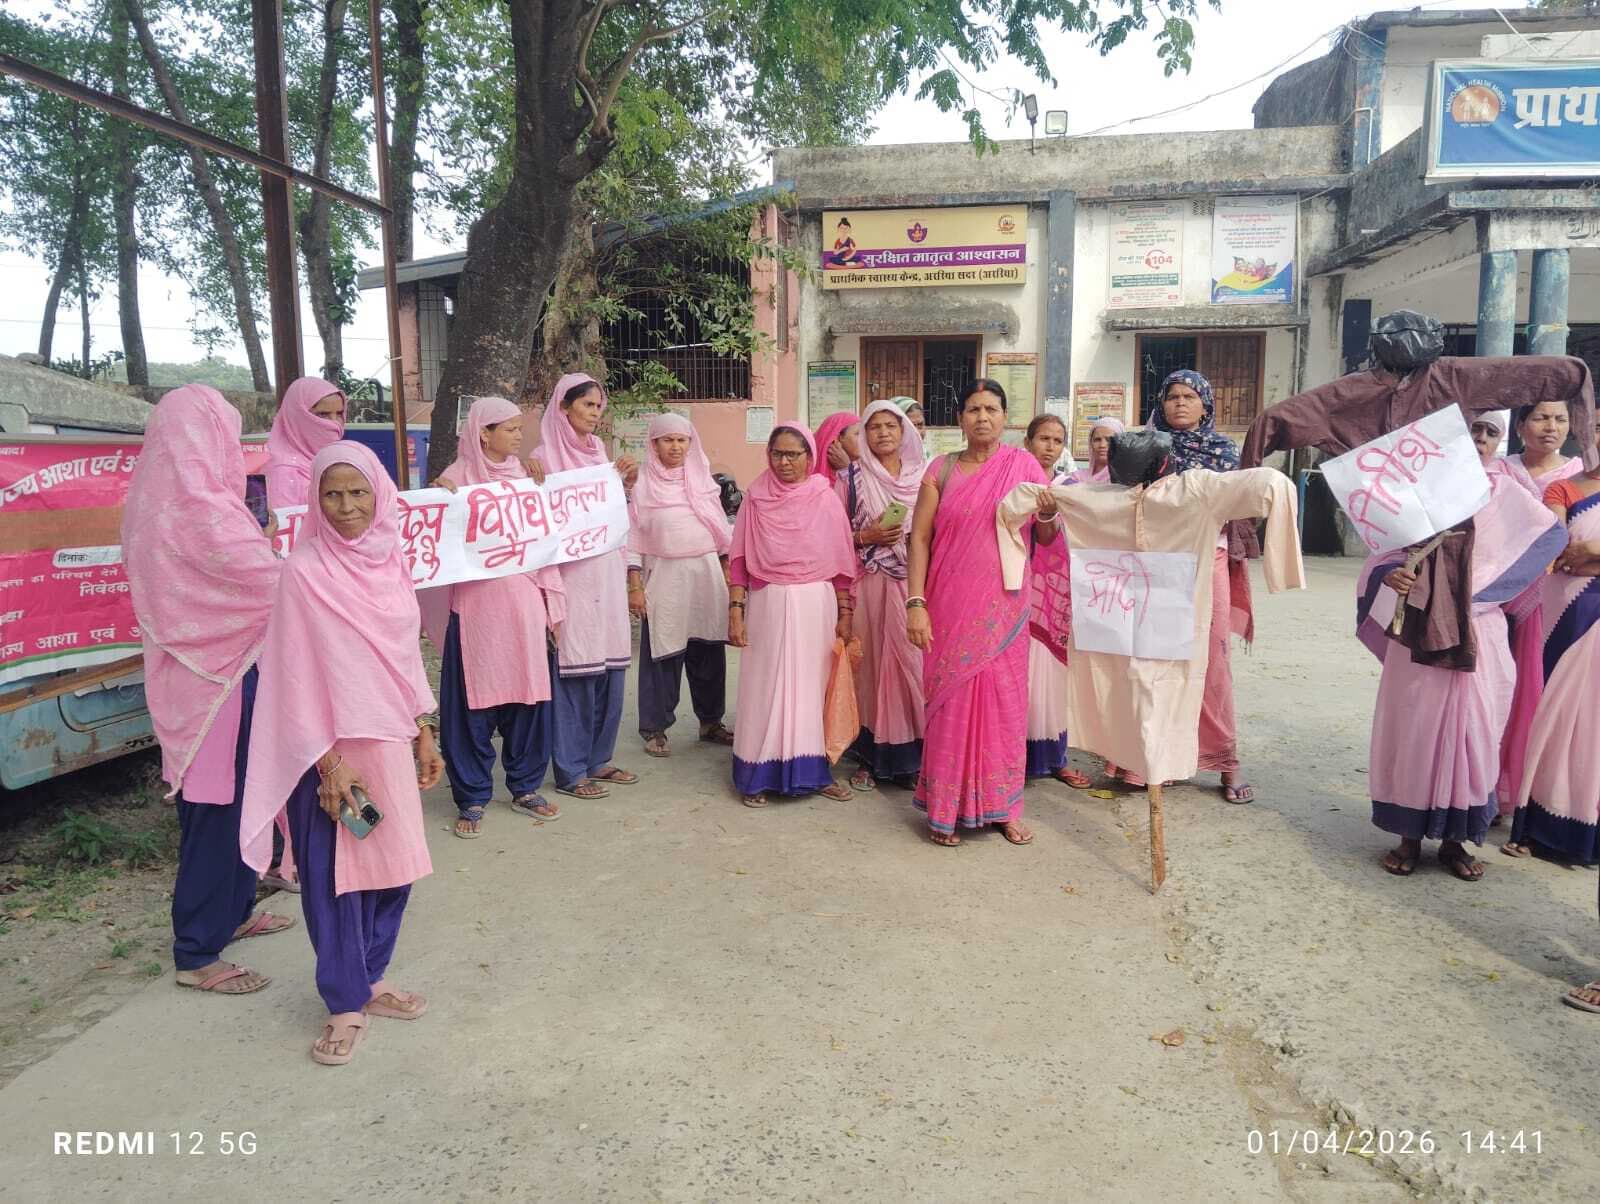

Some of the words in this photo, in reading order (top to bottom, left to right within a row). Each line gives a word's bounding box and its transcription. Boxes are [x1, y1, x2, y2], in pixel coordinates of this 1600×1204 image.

[1512, 86, 1600, 130] प्राथ
[863, 250, 909, 268] सुरक्षित
[913, 251, 952, 266] मातृत्व
[957, 249, 1020, 262] आश्वासन
[924, 268, 955, 281] अररिया
[957, 269, 976, 280] सदर
[978, 266, 1019, 280] (अररिया)
[1151, 255, 1173, 265] 104
[0, 472, 39, 508] ाज्य
[39, 458, 89, 489] आशा
[90, 449, 122, 476] एवं
[465, 479, 549, 544] विरोध
[550, 480, 609, 531] पुतला
[561, 525, 608, 558] दहन
[32, 575, 45, 583] का
[52, 571, 93, 580] परिचय
[80, 579, 130, 597] निवेदक
[1084, 552, 1153, 627] मोदी
[0, 641, 24, 659] ाज्य
[36, 632, 79, 649] आशा
[90, 623, 117, 643] एवं
